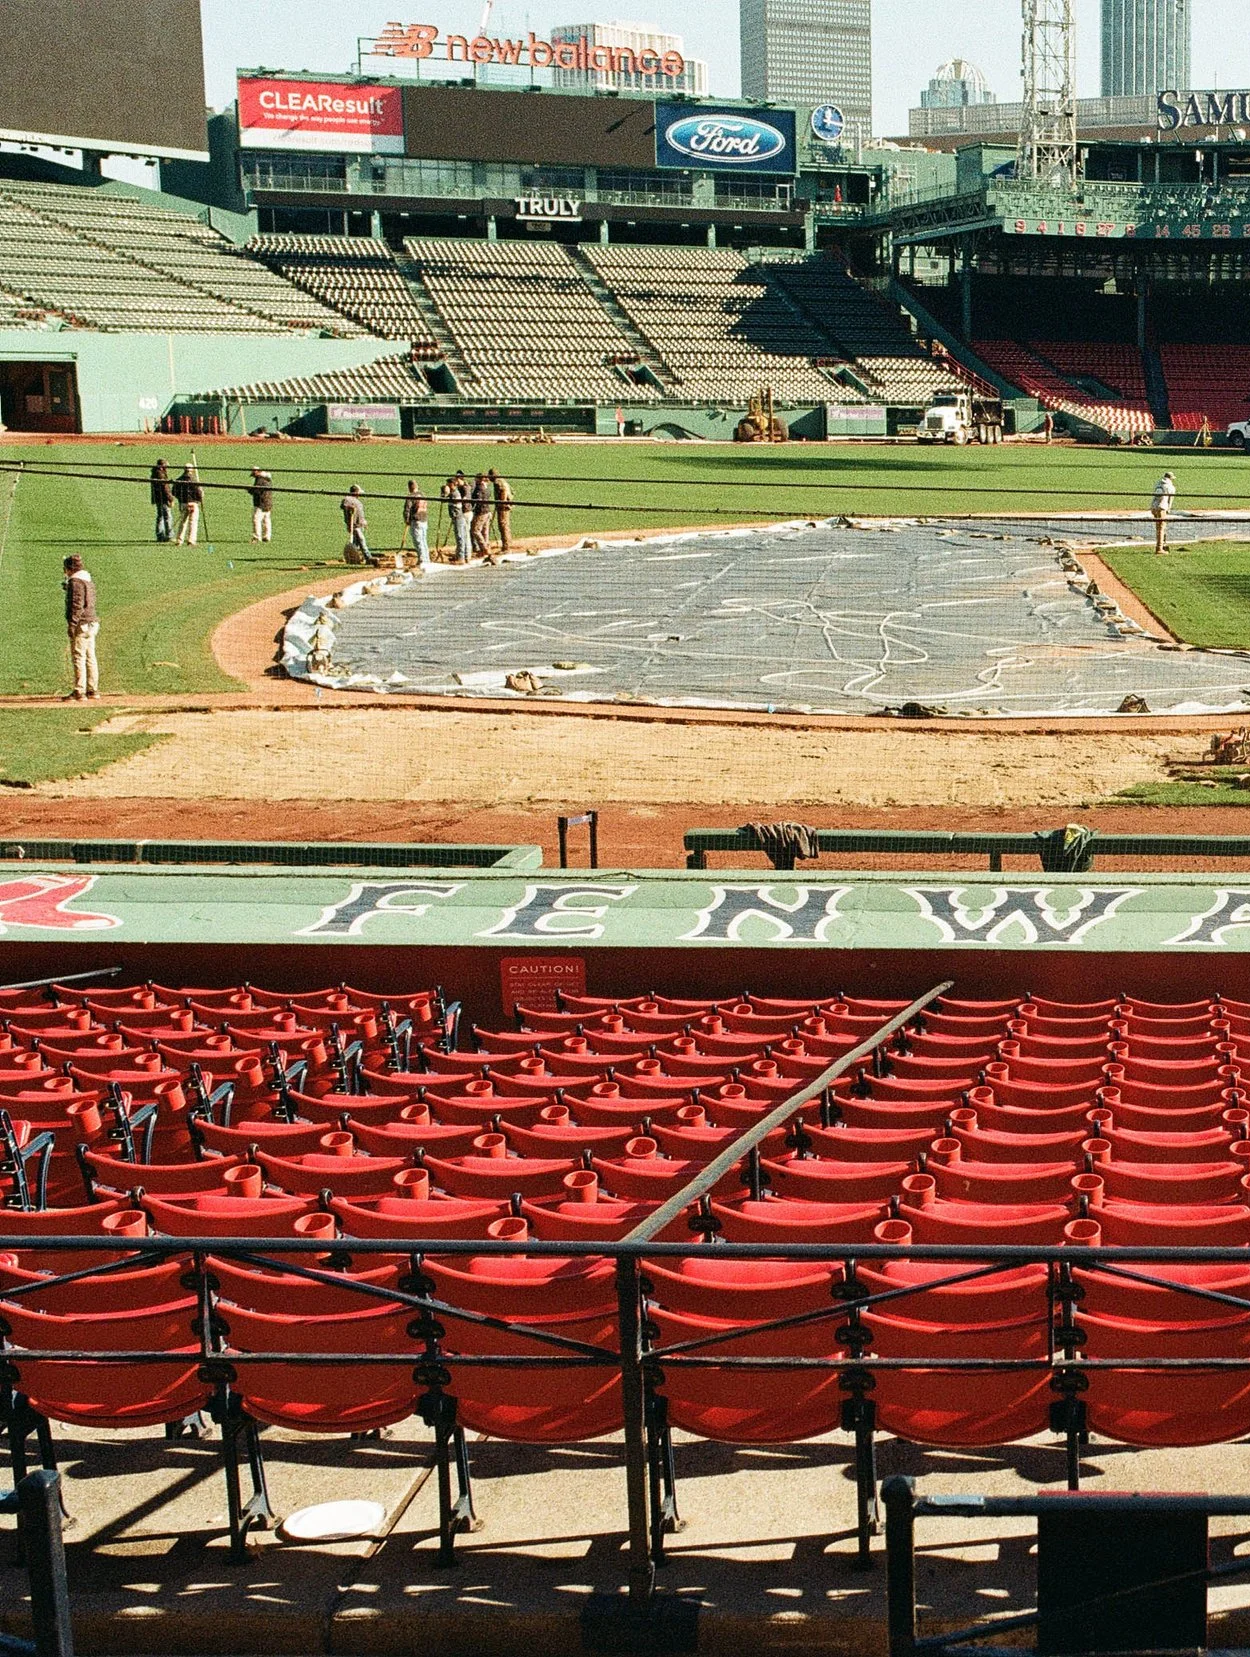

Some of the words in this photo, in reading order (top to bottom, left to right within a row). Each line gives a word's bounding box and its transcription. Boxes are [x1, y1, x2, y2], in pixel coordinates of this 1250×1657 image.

[276, 113, 298, 122] change
[311, 115, 323, 123] way
[324, 116, 345, 125] people
[690, 121, 759, 154] Ford
[514, 196, 580, 216] TRULY
[1014, 219, 1026, 234] 9
[1036, 220, 1047, 235] 4
[1057, 221, 1064, 235] 1
[1096, 222, 1115, 237] 27
[1155, 224, 1170, 238] 14
[1182, 224, 1201, 238] 45
[509, 965, 579, 974] CAUTION!
